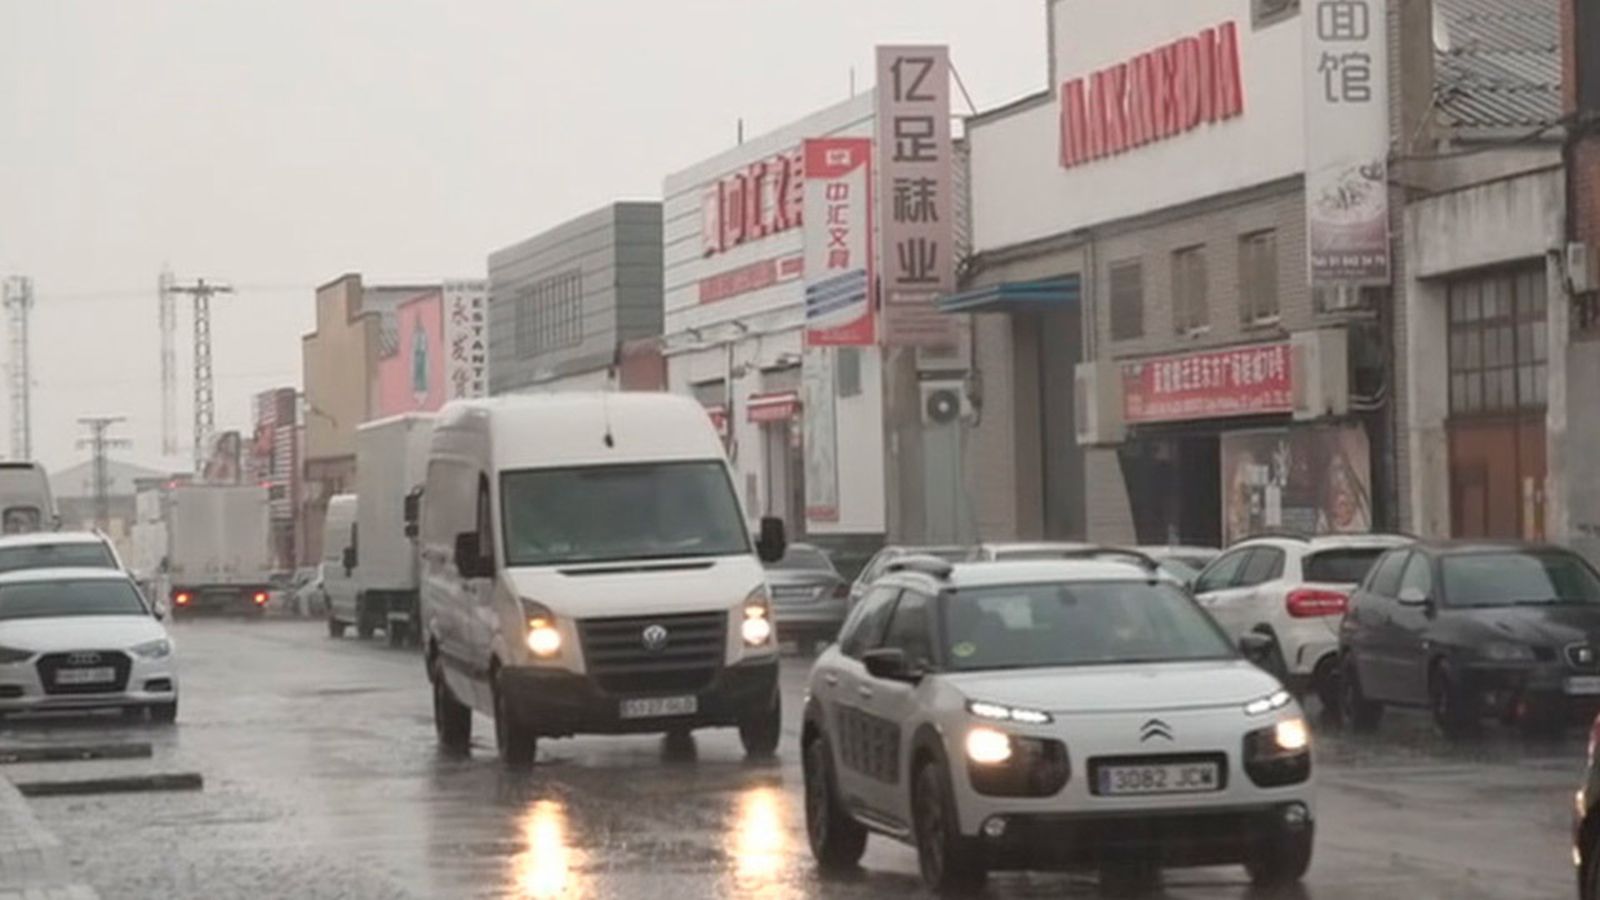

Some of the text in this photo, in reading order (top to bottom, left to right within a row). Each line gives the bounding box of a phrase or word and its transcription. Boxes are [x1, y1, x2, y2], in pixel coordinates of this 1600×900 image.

[889, 55, 941, 285] 亿足袜业
[825, 181, 850, 269] 中汇文具
[472, 298, 485, 398] ESTANTE
